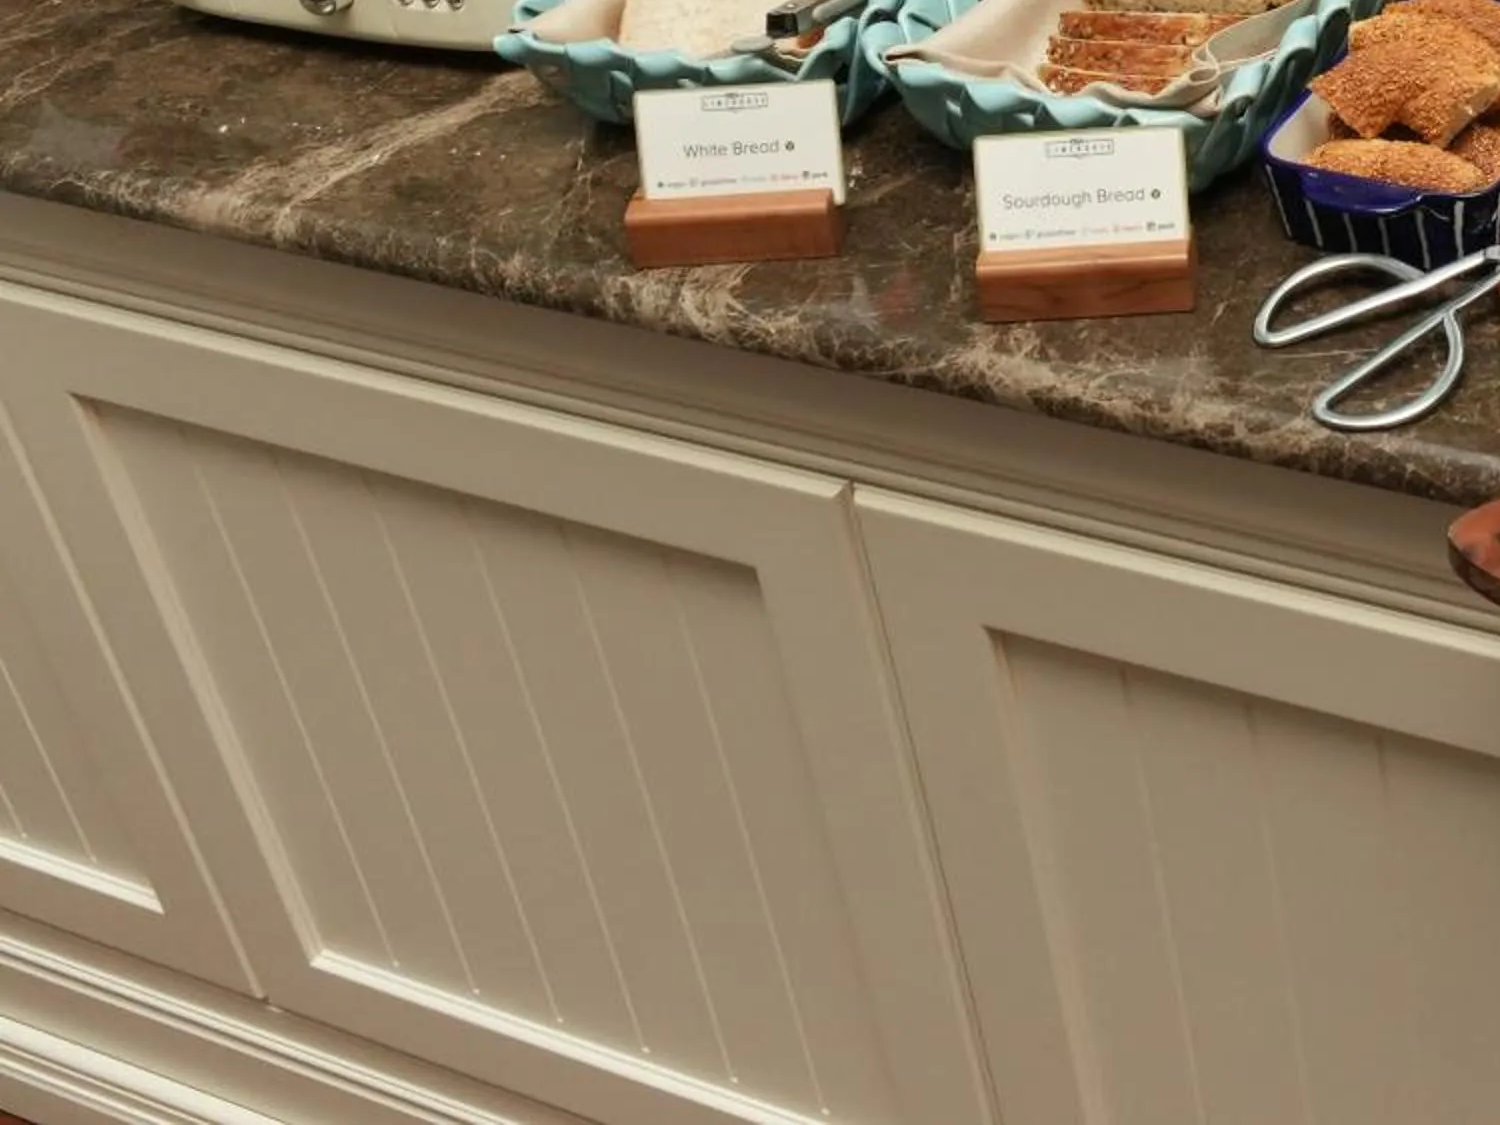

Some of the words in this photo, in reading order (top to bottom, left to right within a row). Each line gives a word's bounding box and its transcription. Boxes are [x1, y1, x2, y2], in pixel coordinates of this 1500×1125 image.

[683, 143, 728, 158] White
[733, 140, 779, 156] Bread
[1002, 189, 1092, 210] Sourdough
[1097, 188, 1145, 204] Bread
